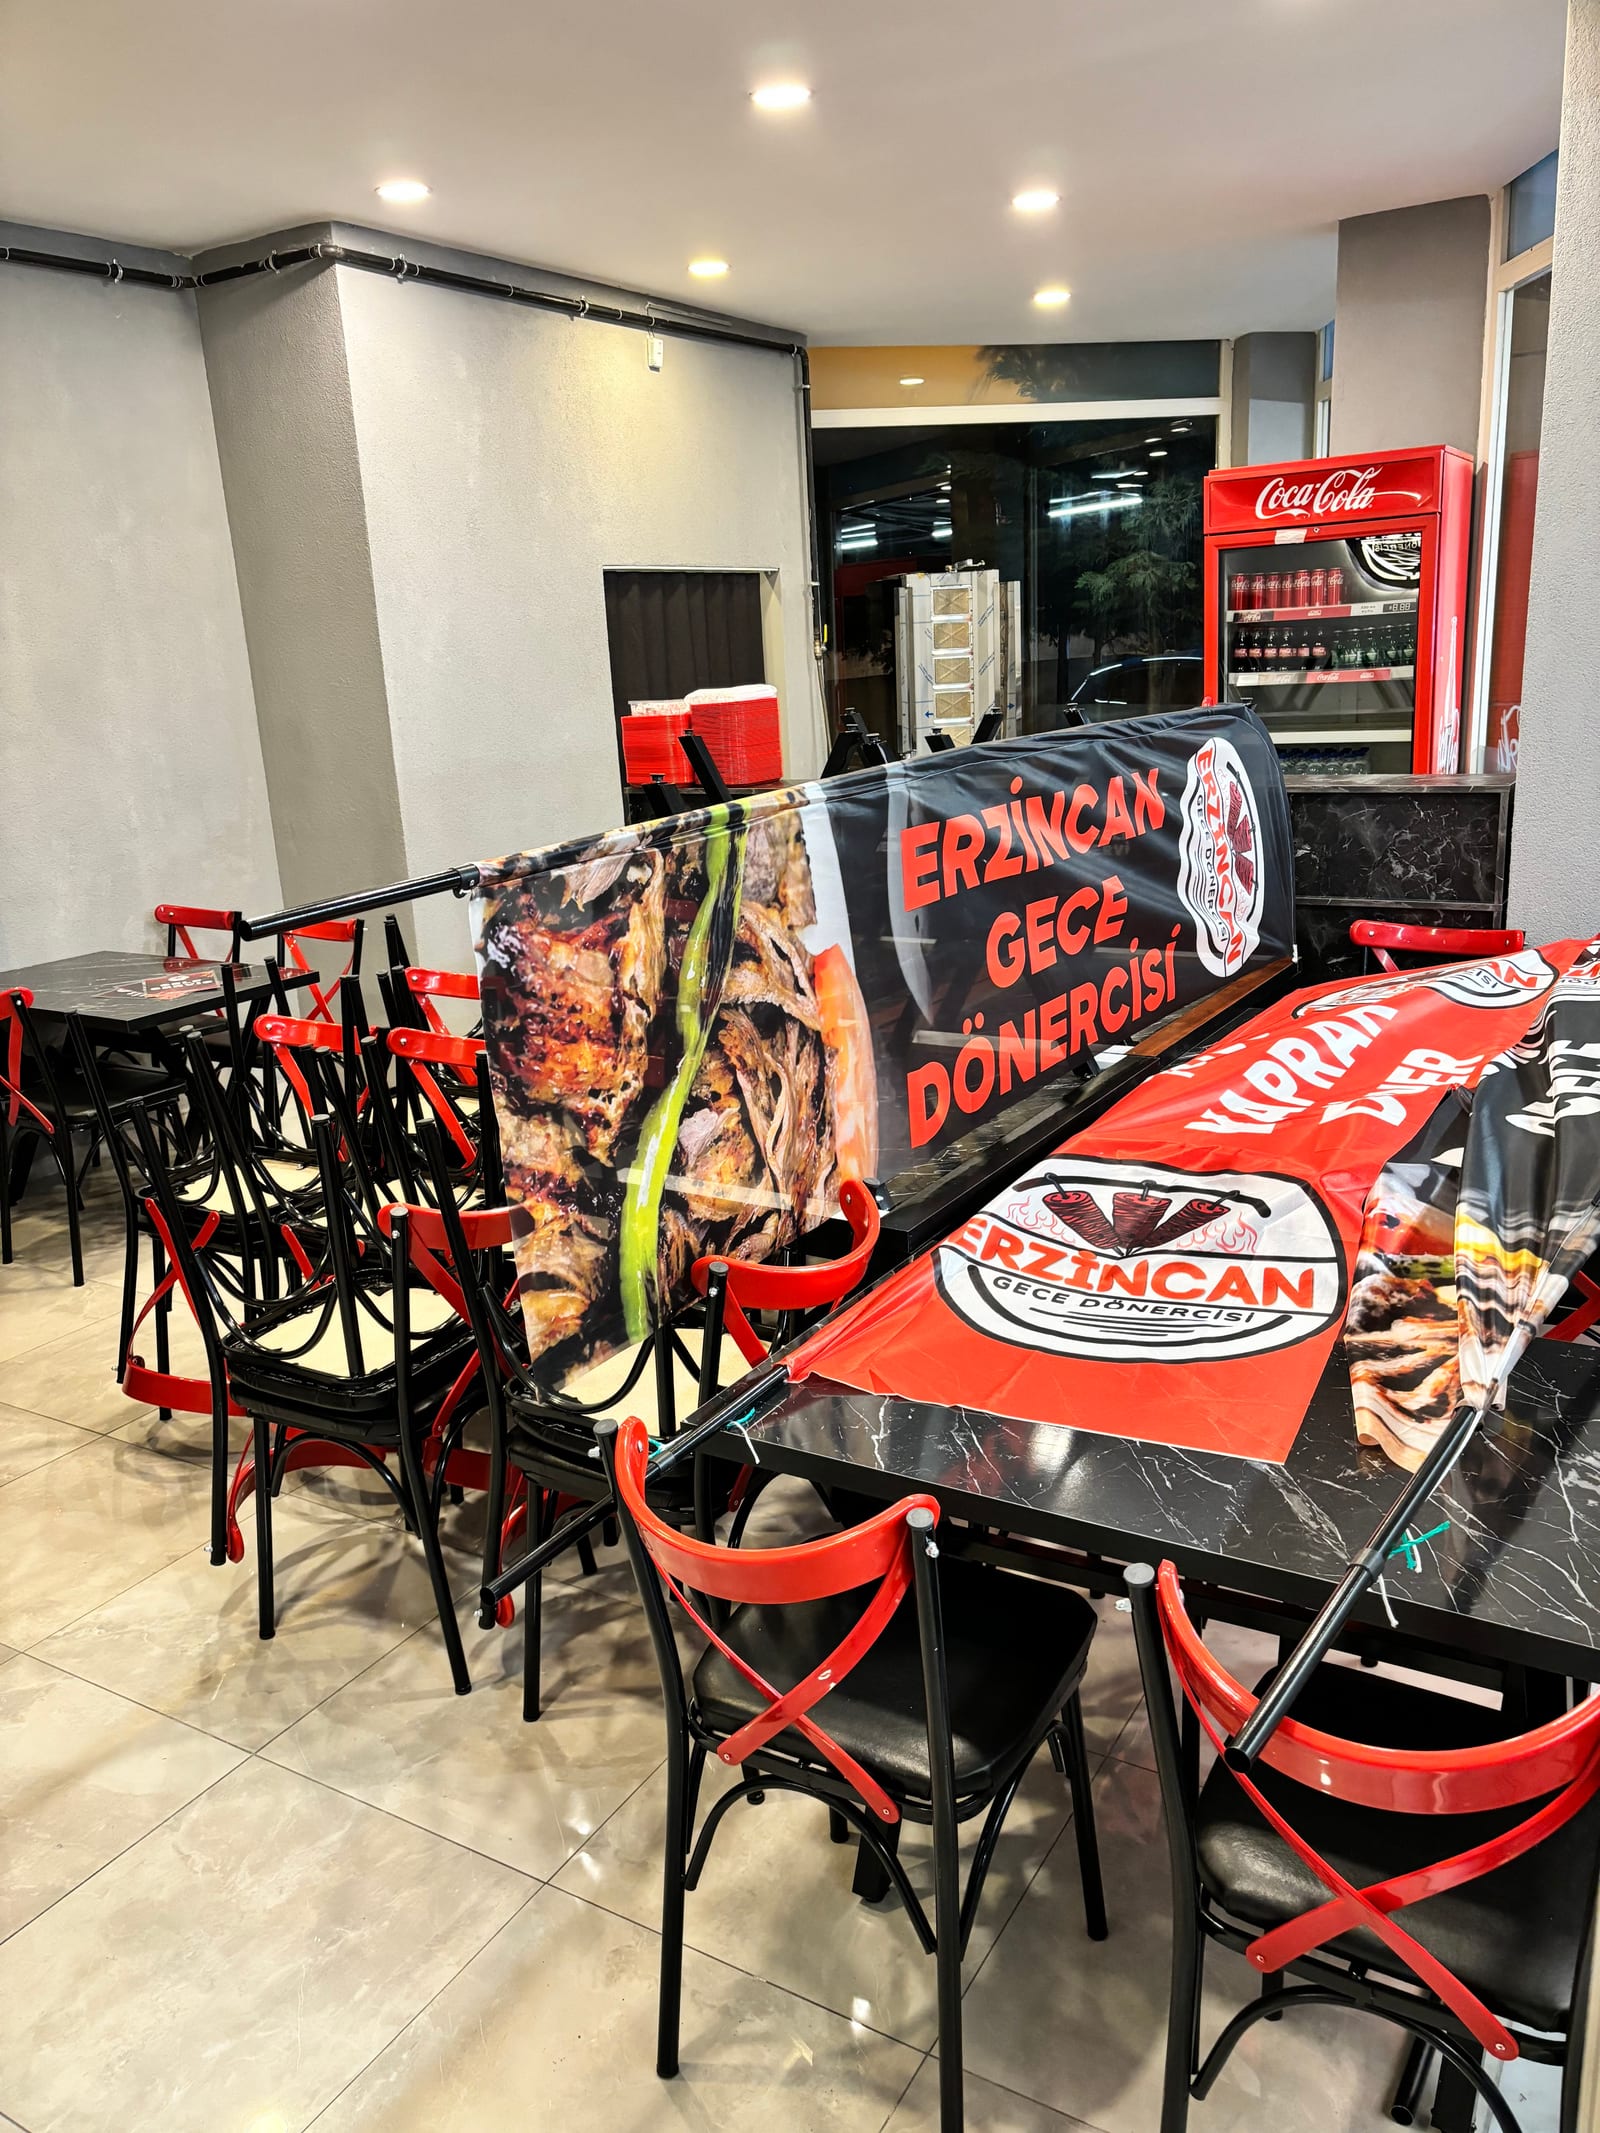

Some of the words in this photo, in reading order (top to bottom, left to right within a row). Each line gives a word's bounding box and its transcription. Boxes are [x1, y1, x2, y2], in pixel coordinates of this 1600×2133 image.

[1255, 466, 1383, 519] Coca-Cola
[901, 768, 1164, 912] ERZİNCAN
[986, 876, 1129, 988] GECE
[906, 923, 1182, 1148] DÖNERCİSİ
[945, 1217, 1314, 1308] ERZİNCAN
[992, 1276, 1070, 1304] GECE
[1079, 1299, 1255, 1324] DÖNERCİSİ
